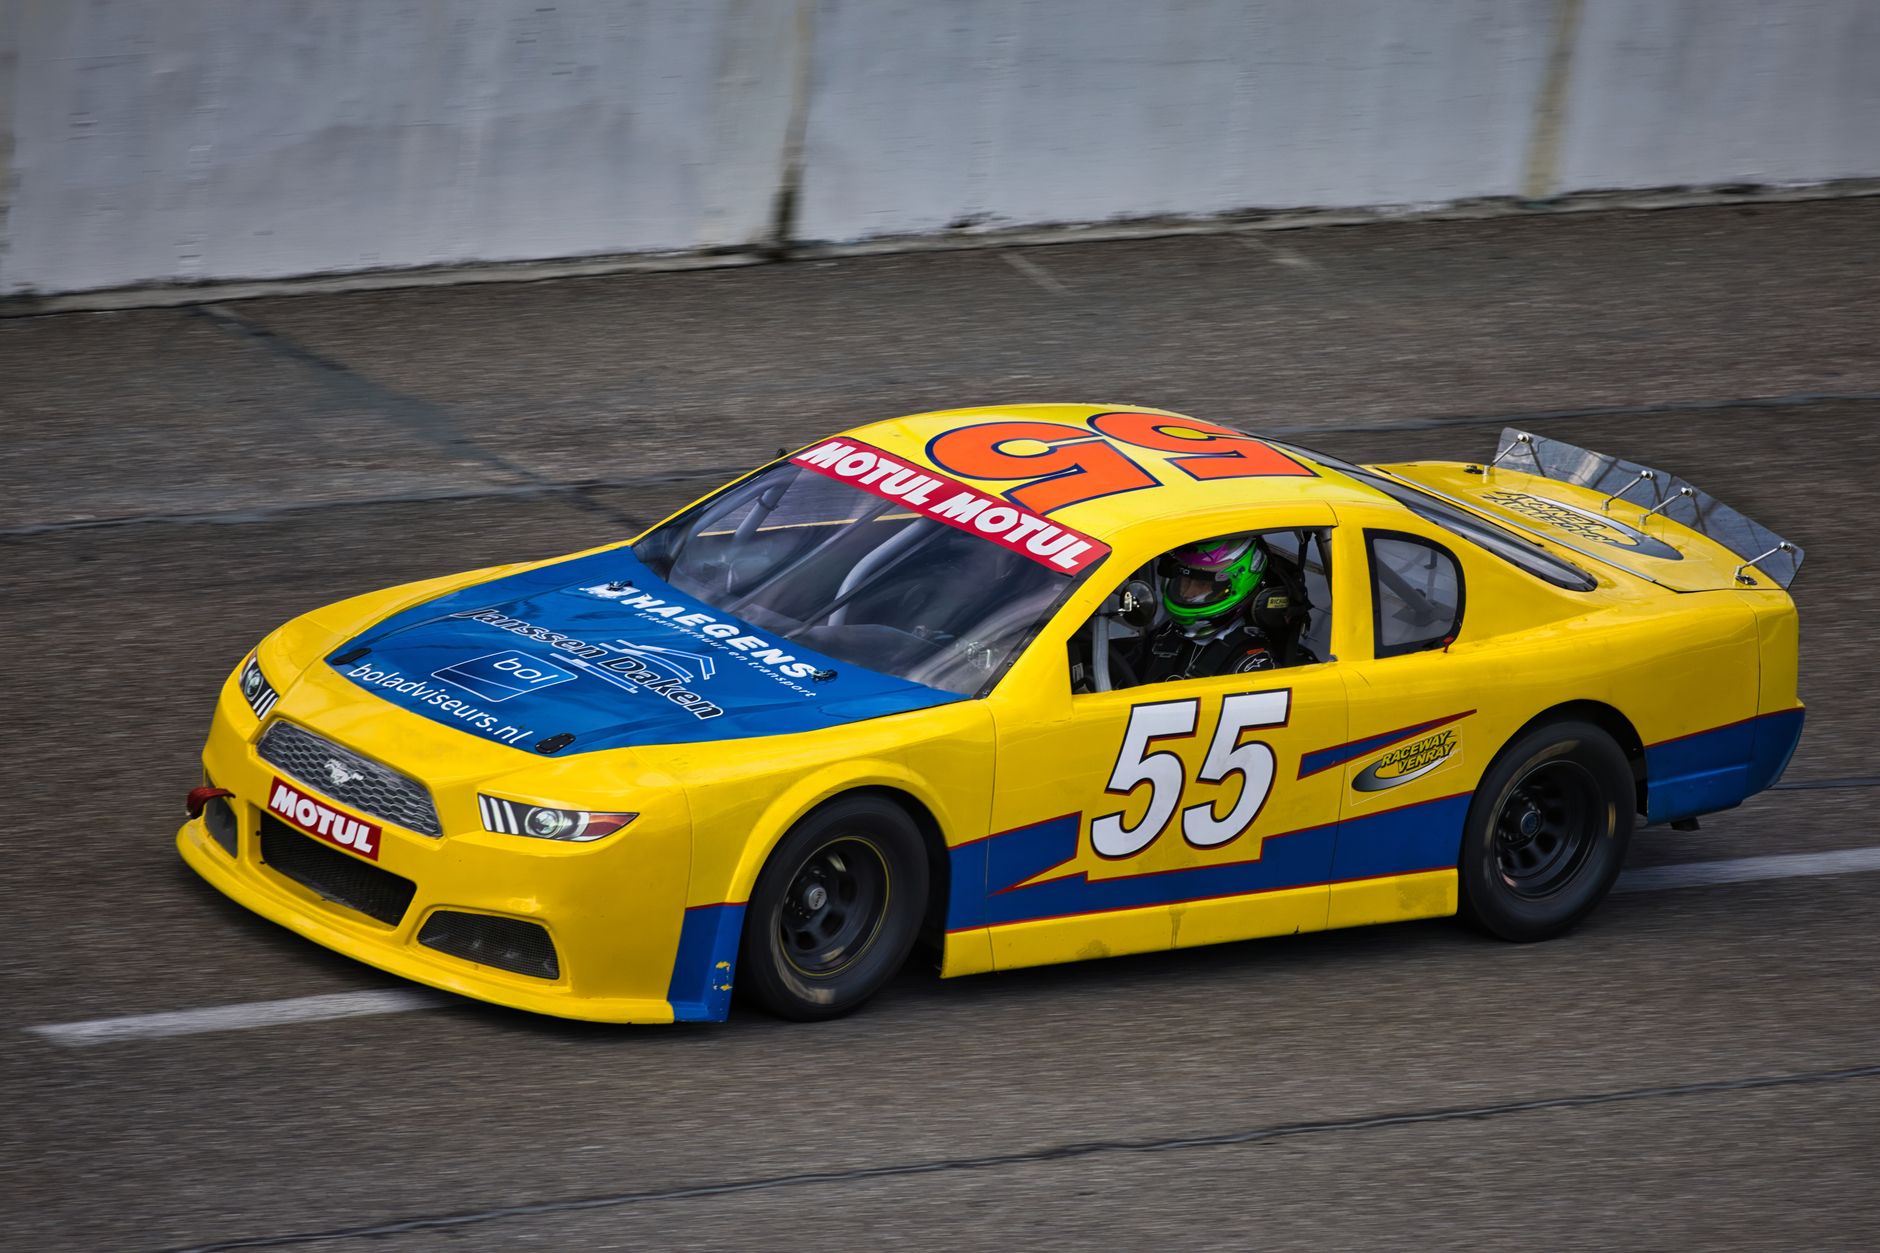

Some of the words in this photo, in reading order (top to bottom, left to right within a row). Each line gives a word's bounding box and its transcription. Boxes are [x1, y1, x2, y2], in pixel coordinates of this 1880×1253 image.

[796, 440, 945, 506] MOTUL
[928, 492, 1095, 569] MOTUL
[924, 411, 1322, 516] 55
[451, 608, 609, 659] Janssen
[597, 656, 725, 720] Daken
[493, 657, 559, 684] bol
[620, 593, 818, 679] HAEGENS
[634, 612, 729, 651] kraanverhuur
[728, 650, 749, 662] en
[748, 662, 817, 698] transport
[347, 663, 534, 745] boladviseurs.nl
[1090, 687, 1293, 861] 55
[1380, 730, 1453, 769] RACEWAY
[1398, 741, 1457, 774] VENRAY
[269, 784, 374, 855] MOTUL
